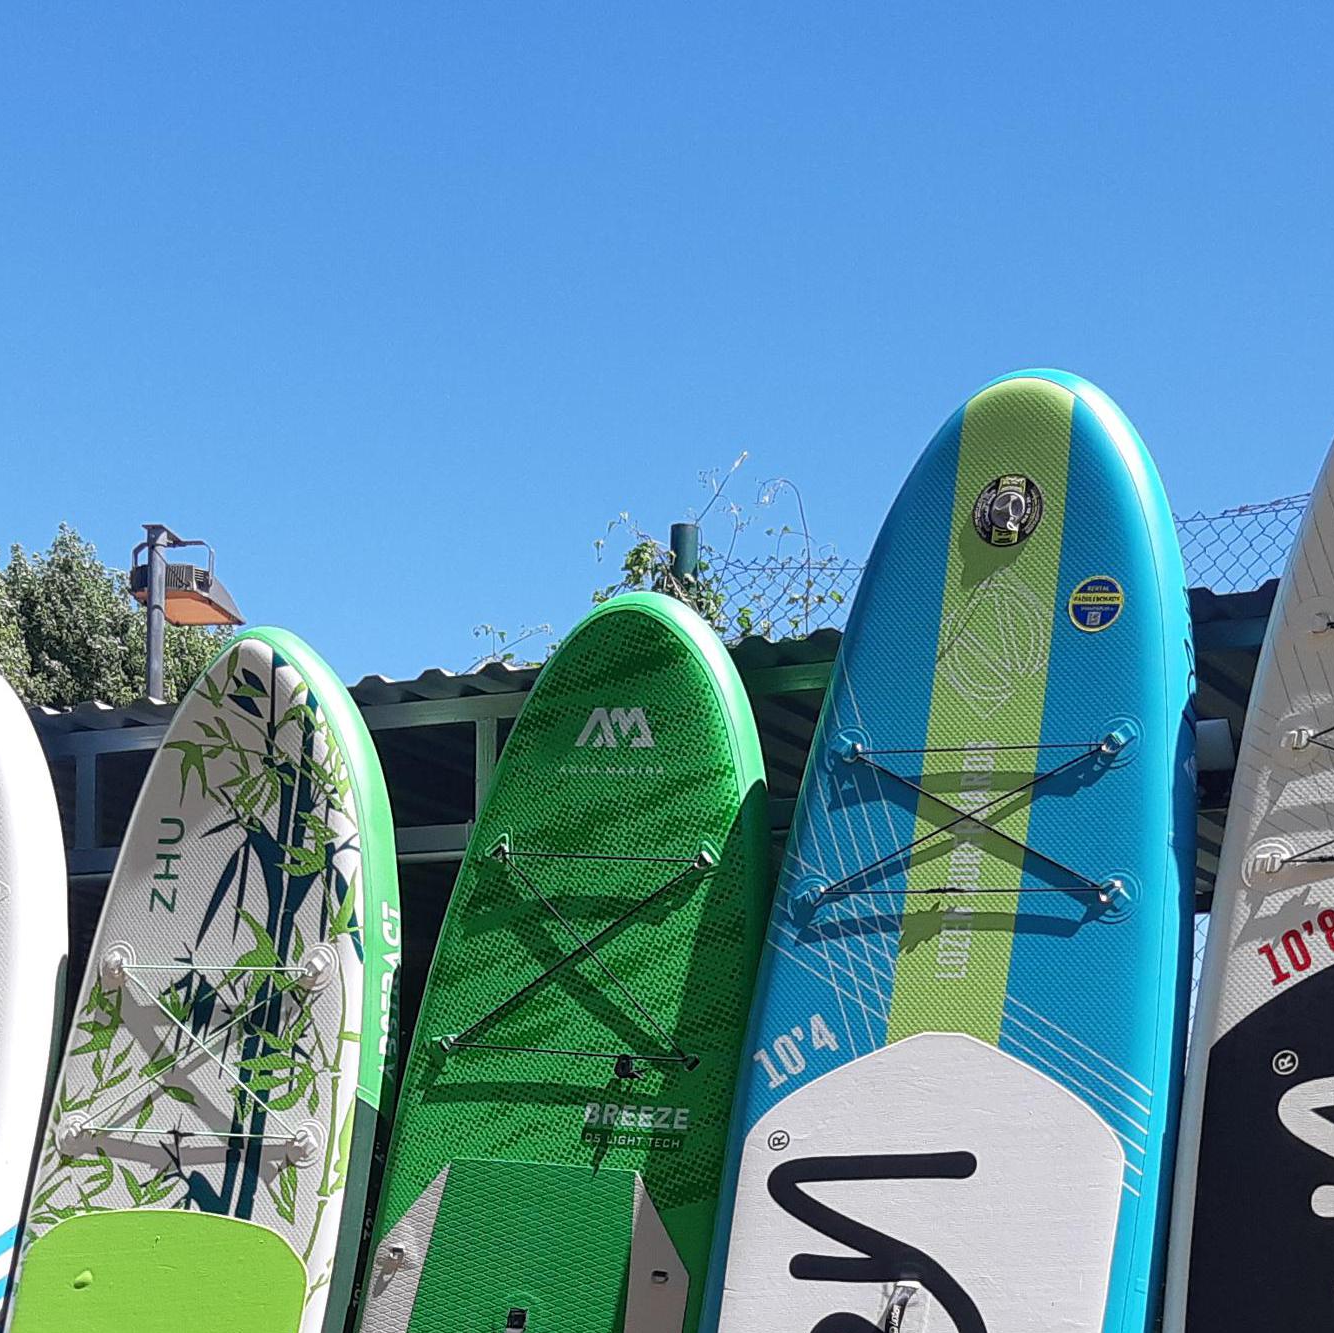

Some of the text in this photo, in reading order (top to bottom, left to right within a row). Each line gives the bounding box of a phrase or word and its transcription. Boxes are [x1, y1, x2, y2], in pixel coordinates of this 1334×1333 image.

[149, 816, 185, 912] ZHU
[754, 1013, 839, 1089] 10'4
[584, 1102, 689, 1129] BREEZE
[606, 1134, 643, 1146] LIGHT
[648, 1137, 680, 1148] TECH
